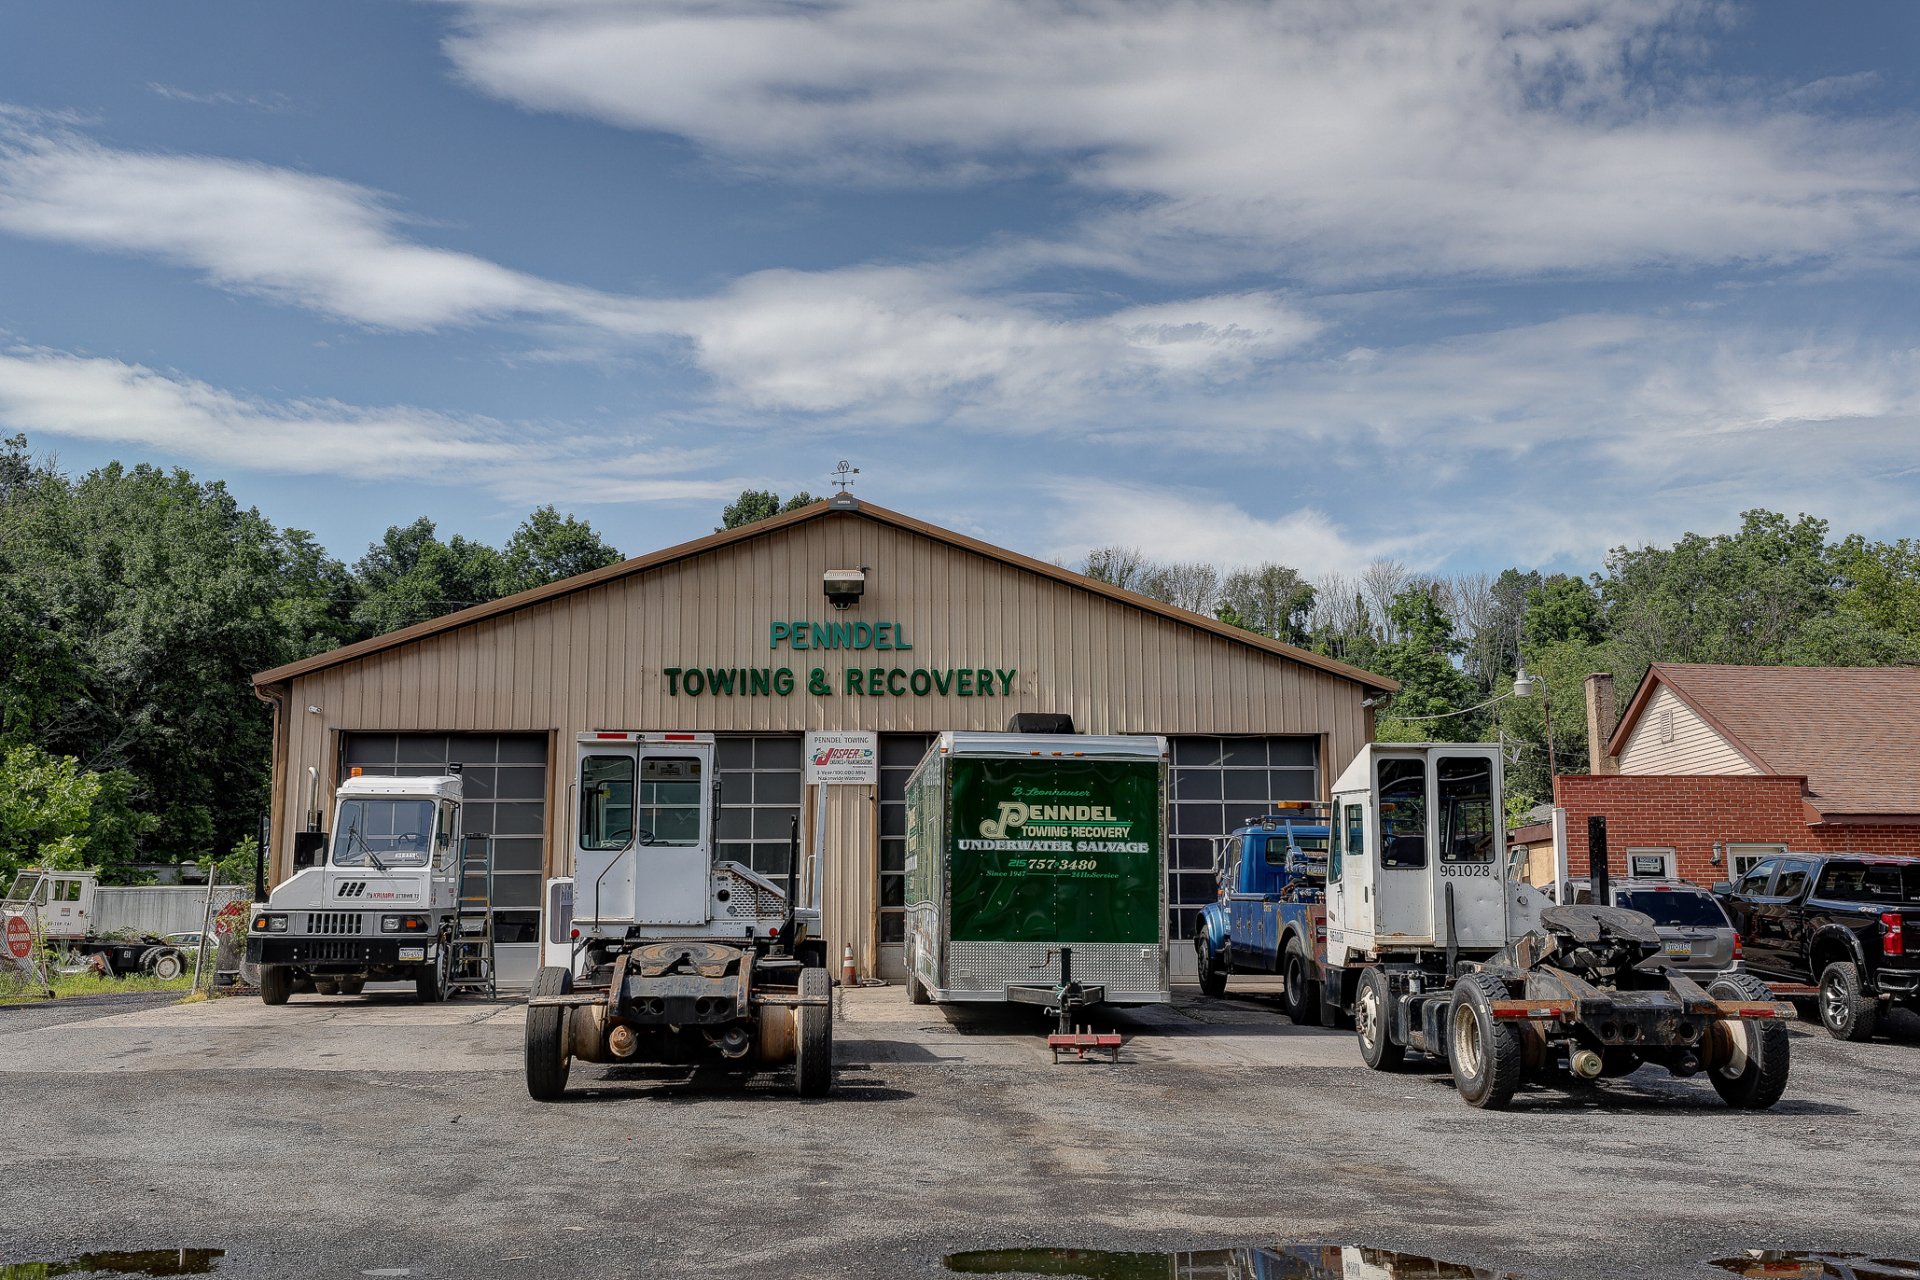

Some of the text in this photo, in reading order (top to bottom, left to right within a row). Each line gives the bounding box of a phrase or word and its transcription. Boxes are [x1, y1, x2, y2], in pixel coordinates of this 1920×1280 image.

[769, 621, 913, 650] PENNDEL
[664, 667, 1017, 696] TOWING & RECOVERY
[814, 736, 869, 744] PENNDEL TOWING
[815, 747, 860, 766] JASPER
[979, 801, 1118, 840] PENNDEL
[1021, 826, 1130, 838] TOWING RECOVERY
[958, 839, 1150, 853] UNDERWATER SALVAGE
[1008, 859, 1027, 867] 215
[1440, 865, 1490, 877] 961028
